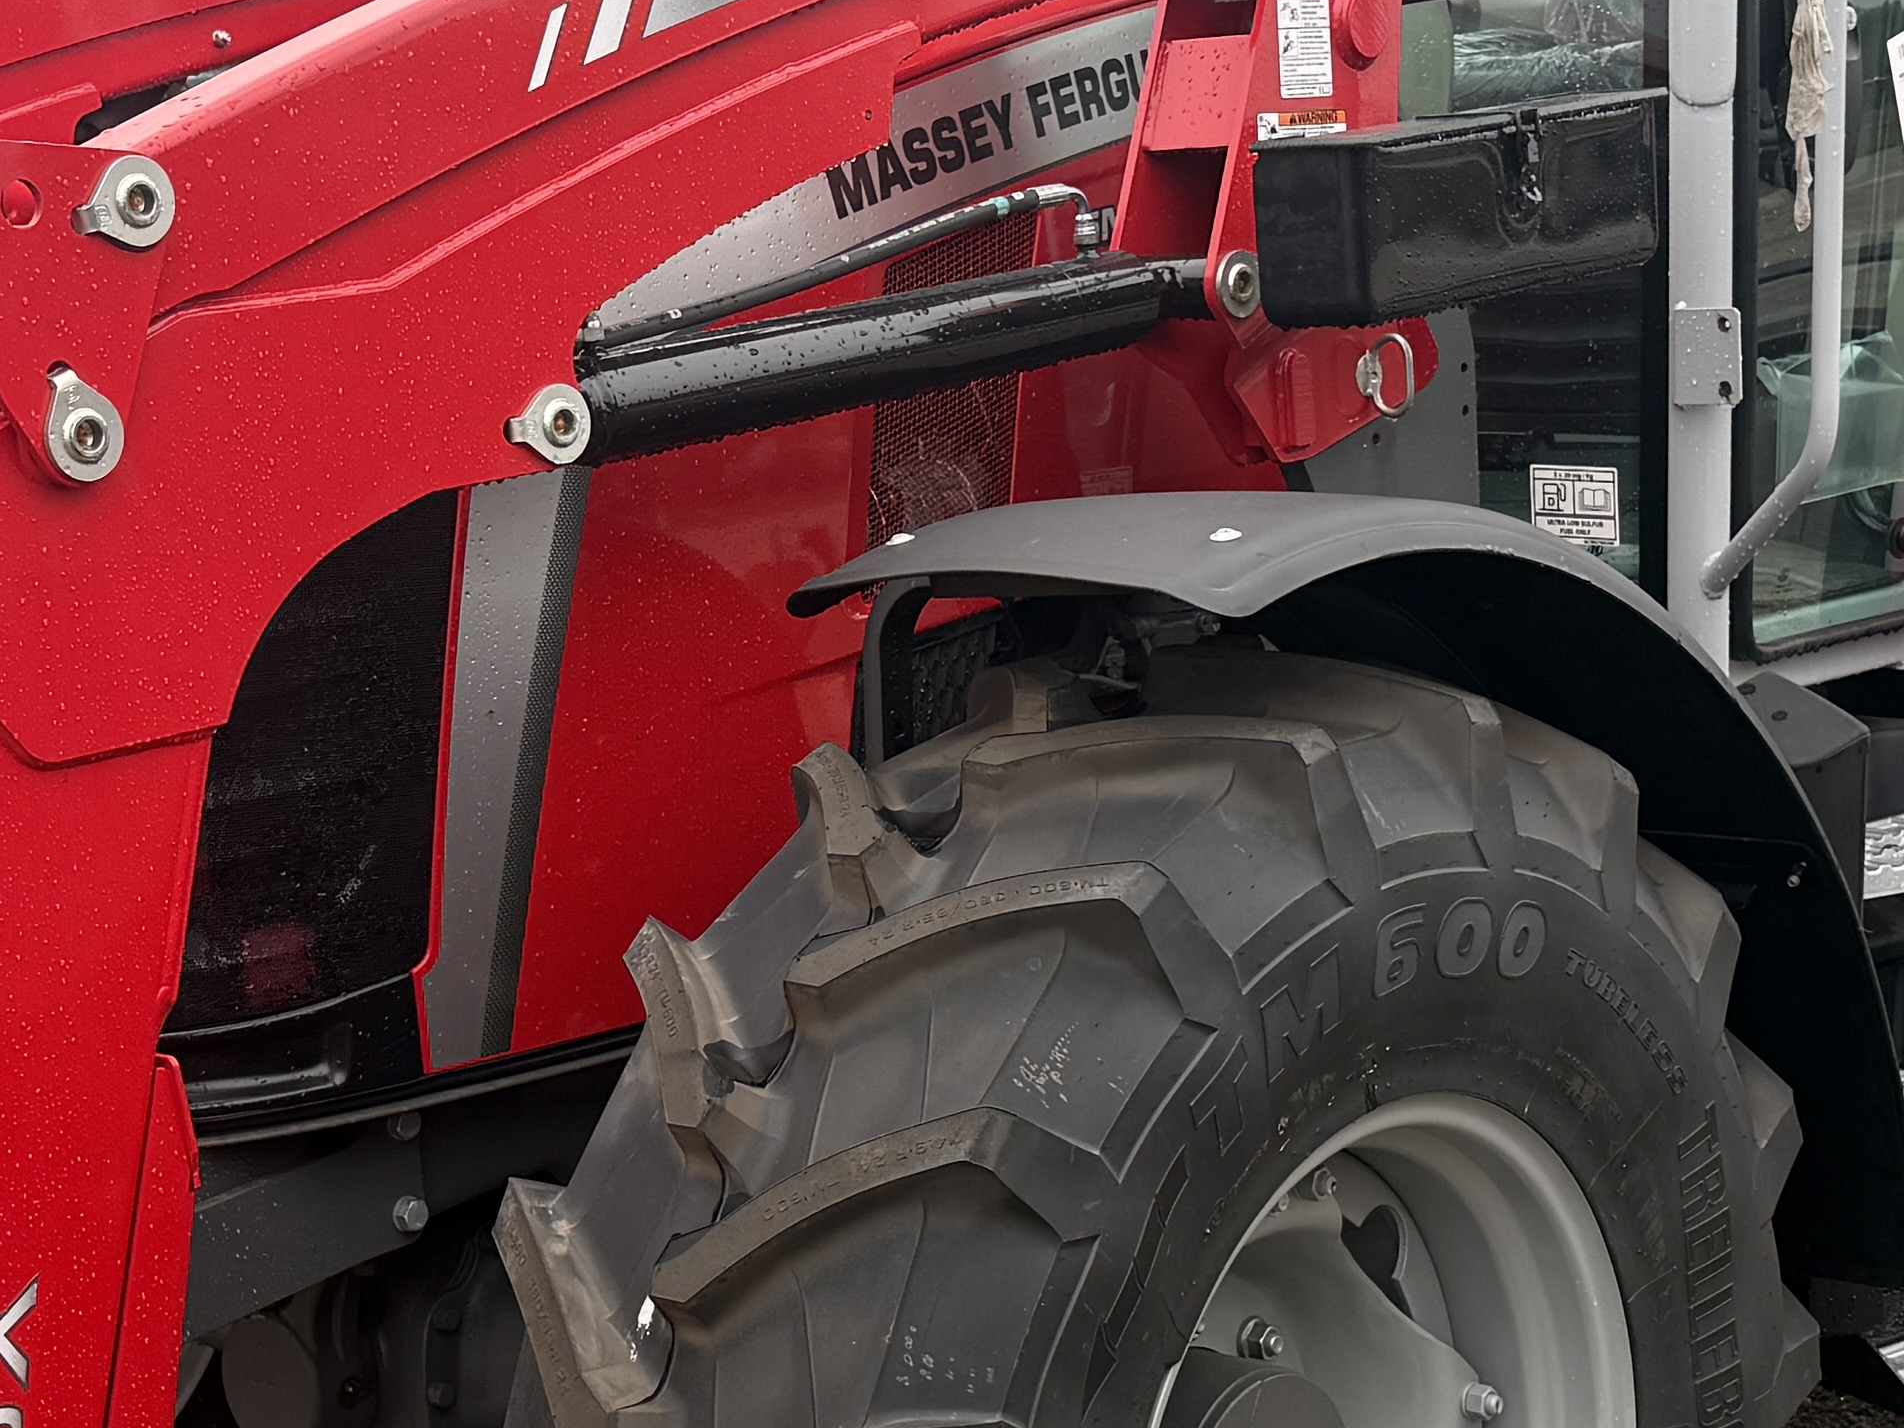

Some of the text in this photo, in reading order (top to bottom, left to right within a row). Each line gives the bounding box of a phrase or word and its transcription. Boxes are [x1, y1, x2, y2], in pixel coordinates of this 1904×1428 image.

[825, 91, 1014, 219] MASSEY
[1189, 942, 1342, 1160] TM
[1372, 895, 1549, 1000] 600
[1563, 946, 1689, 1096] TUBELESS
